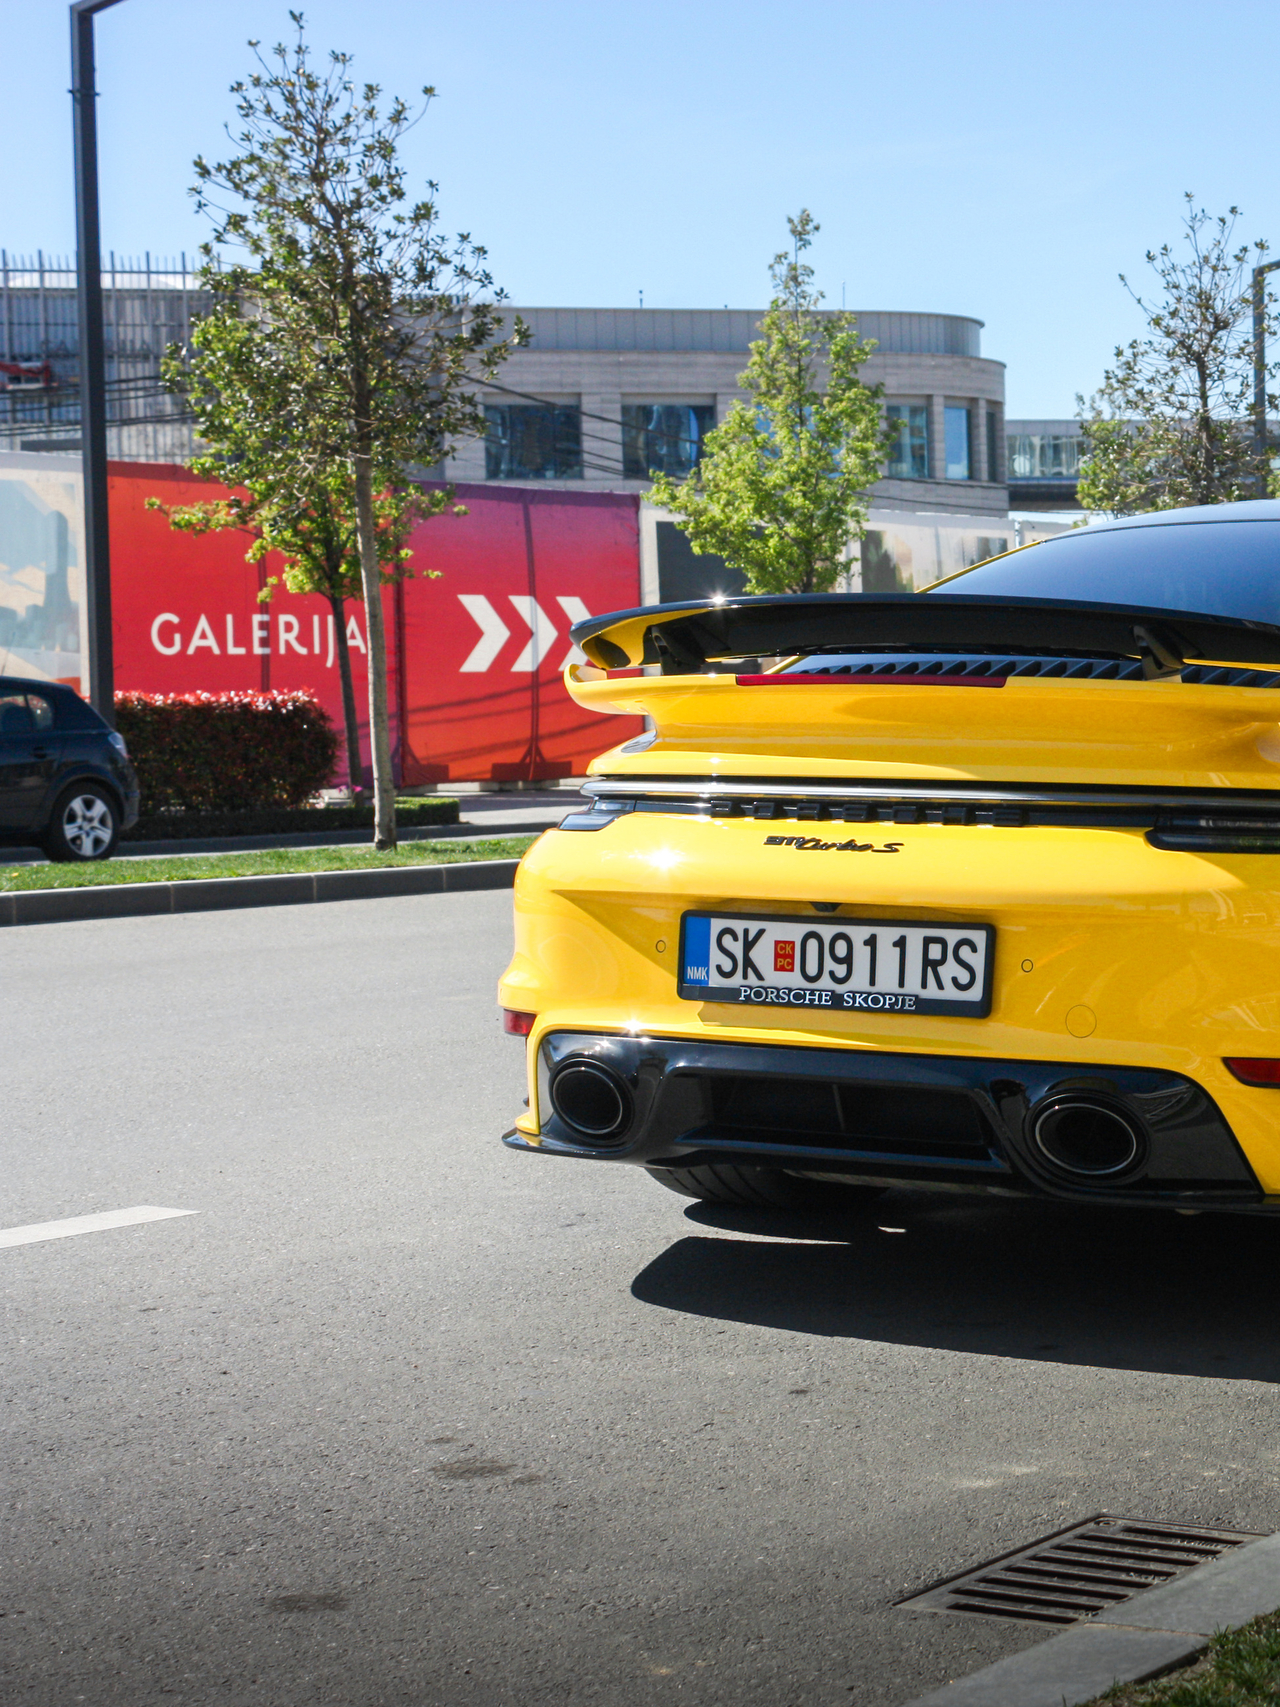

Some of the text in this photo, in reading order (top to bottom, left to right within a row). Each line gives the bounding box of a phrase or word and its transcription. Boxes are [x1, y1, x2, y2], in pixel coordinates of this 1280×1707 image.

[150, 612, 367, 668] GALERIJA
[686, 966, 708, 981] NMK
[716, 927, 766, 981] SK
[738, 986, 917, 1011] PORSCHE SKOPJE
